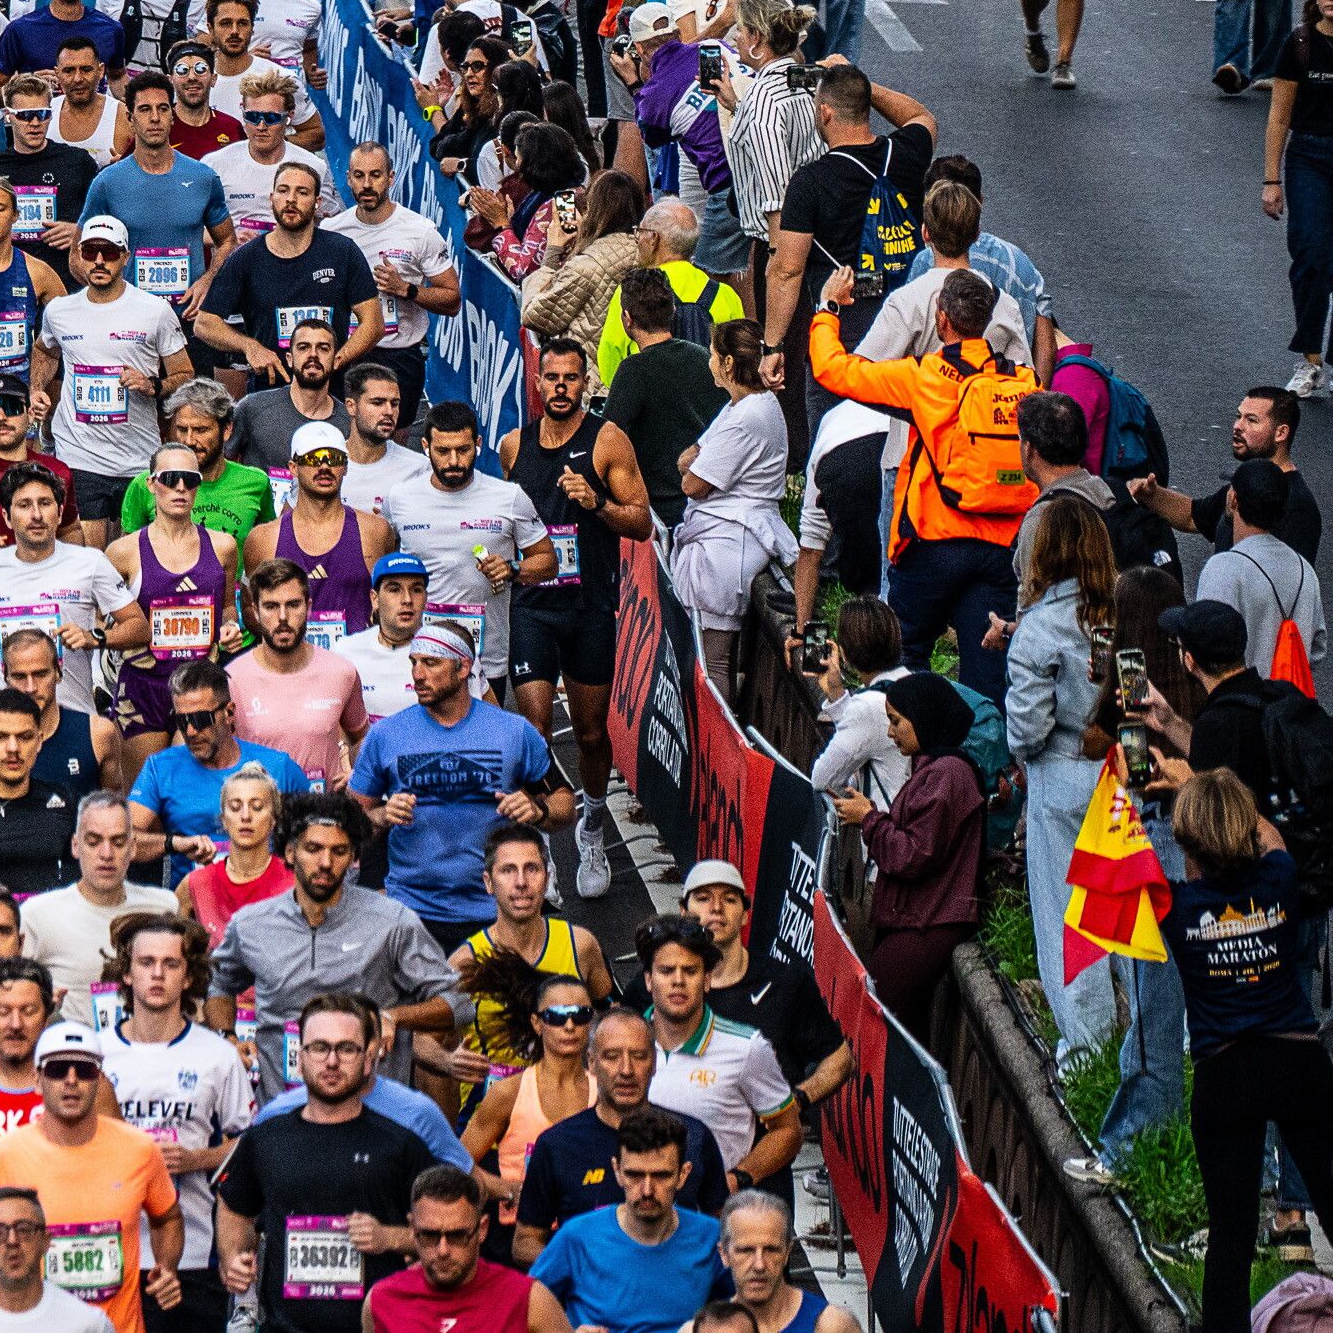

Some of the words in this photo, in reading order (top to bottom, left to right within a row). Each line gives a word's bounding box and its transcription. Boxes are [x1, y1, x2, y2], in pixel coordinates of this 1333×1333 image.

[148, 267, 178, 284] 2896
[61, 334, 84, 342] BROOKS
[87, 385, 111, 403] 4111
[163, 617, 200, 636] 30790
[171, 649, 192, 658] 2026
[407, 771, 468, 786] FREEDOM
[1217, 936, 1264, 954] MEDIA
[62, 1249, 103, 1273] 5882
[300, 1245, 349, 1268] 36392
[309, 1285, 336, 1296] 2026
